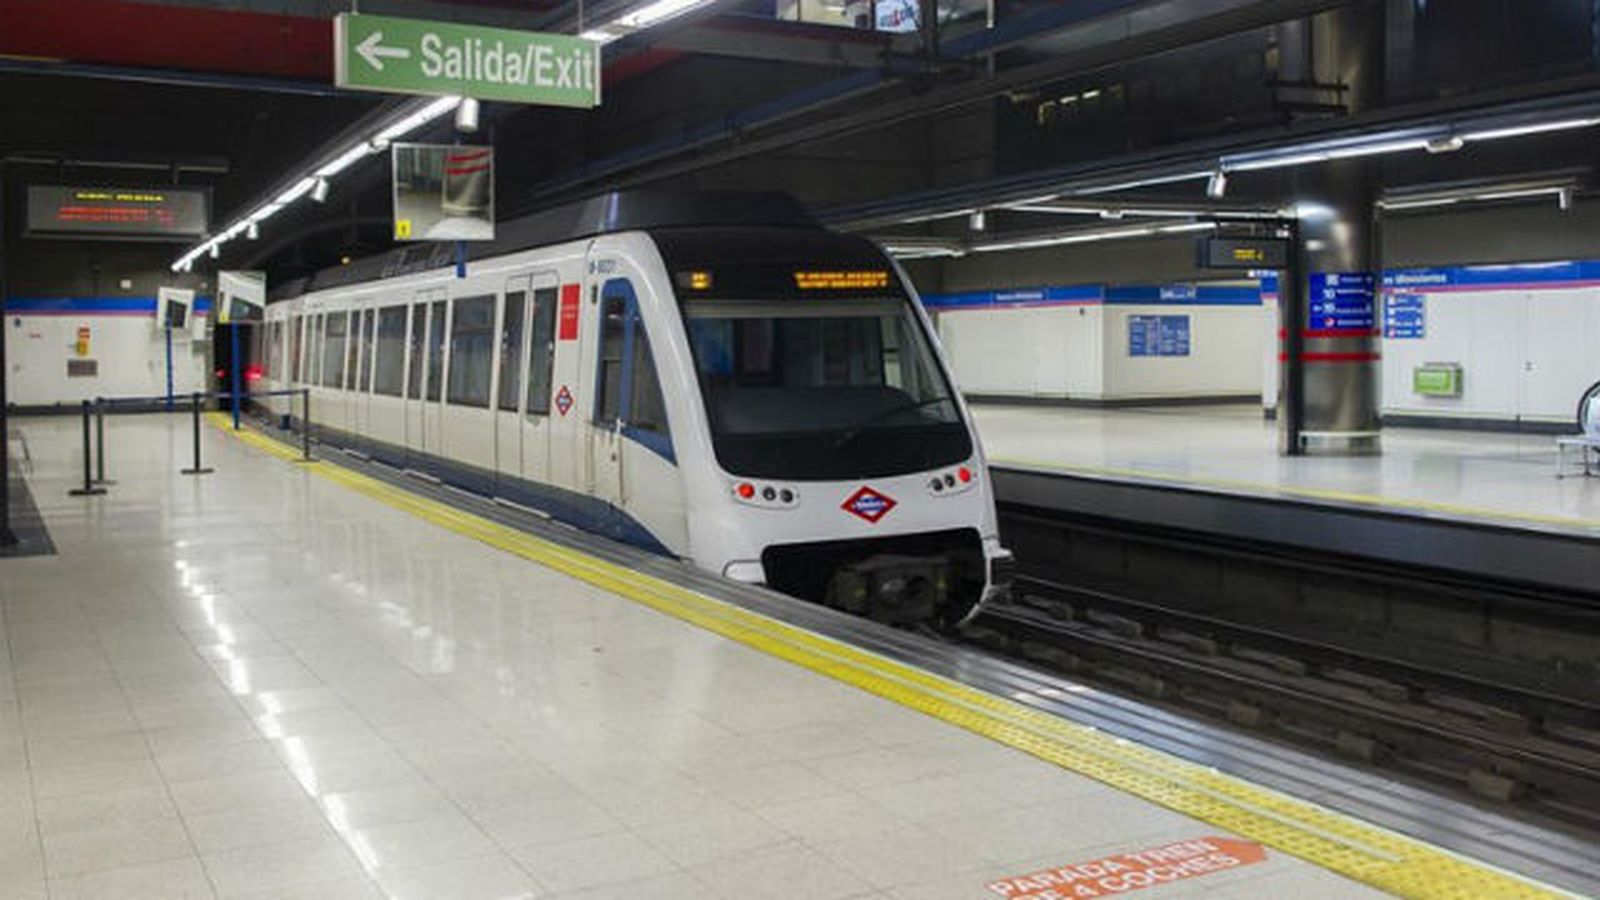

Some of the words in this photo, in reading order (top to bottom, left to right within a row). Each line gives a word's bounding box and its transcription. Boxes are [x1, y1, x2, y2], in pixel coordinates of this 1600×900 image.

[420, 33, 594, 90] Salida/Exit
[988, 860, 1131, 898] PARADA
[1125, 840, 1220, 865] TREN
[1075, 883, 1100, 898] 4
[1098, 853, 1241, 891] COCHES
